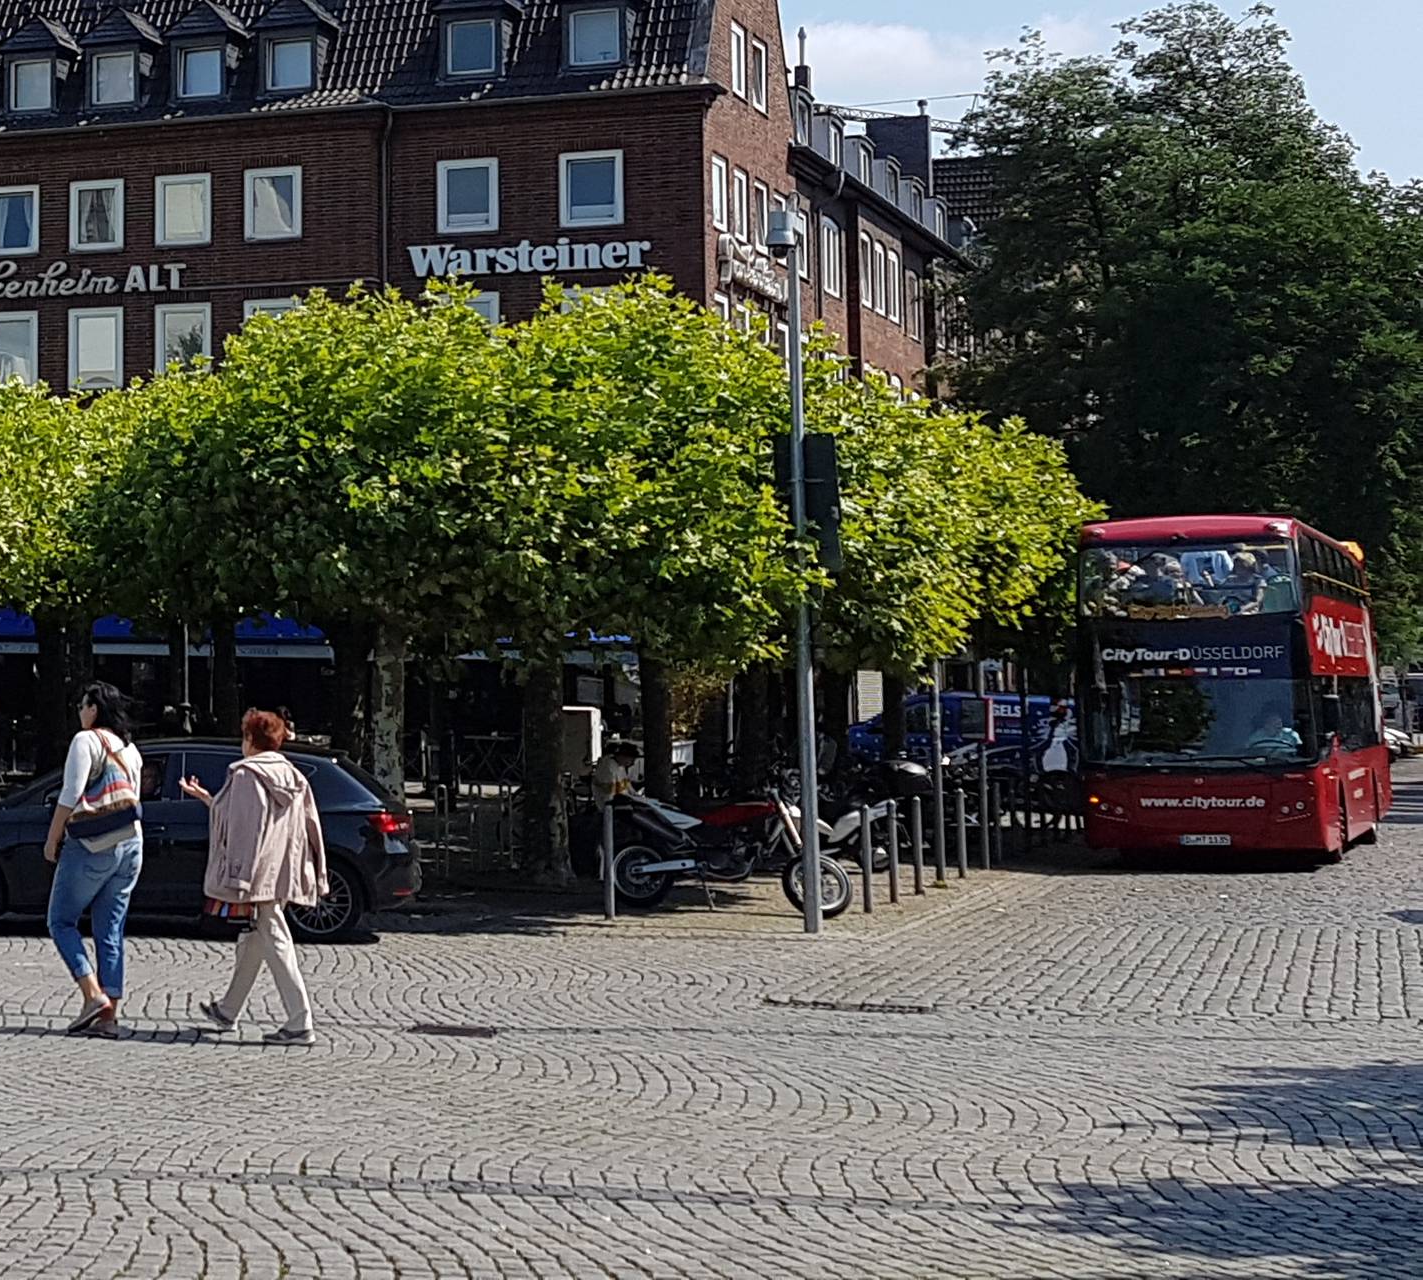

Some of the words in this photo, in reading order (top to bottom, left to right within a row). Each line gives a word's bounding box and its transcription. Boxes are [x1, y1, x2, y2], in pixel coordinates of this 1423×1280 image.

[407, 237, 652, 277] Warsteiner
[124, 263, 187, 292] ALT
[1140, 796, 1266, 809] www.citytour.de
